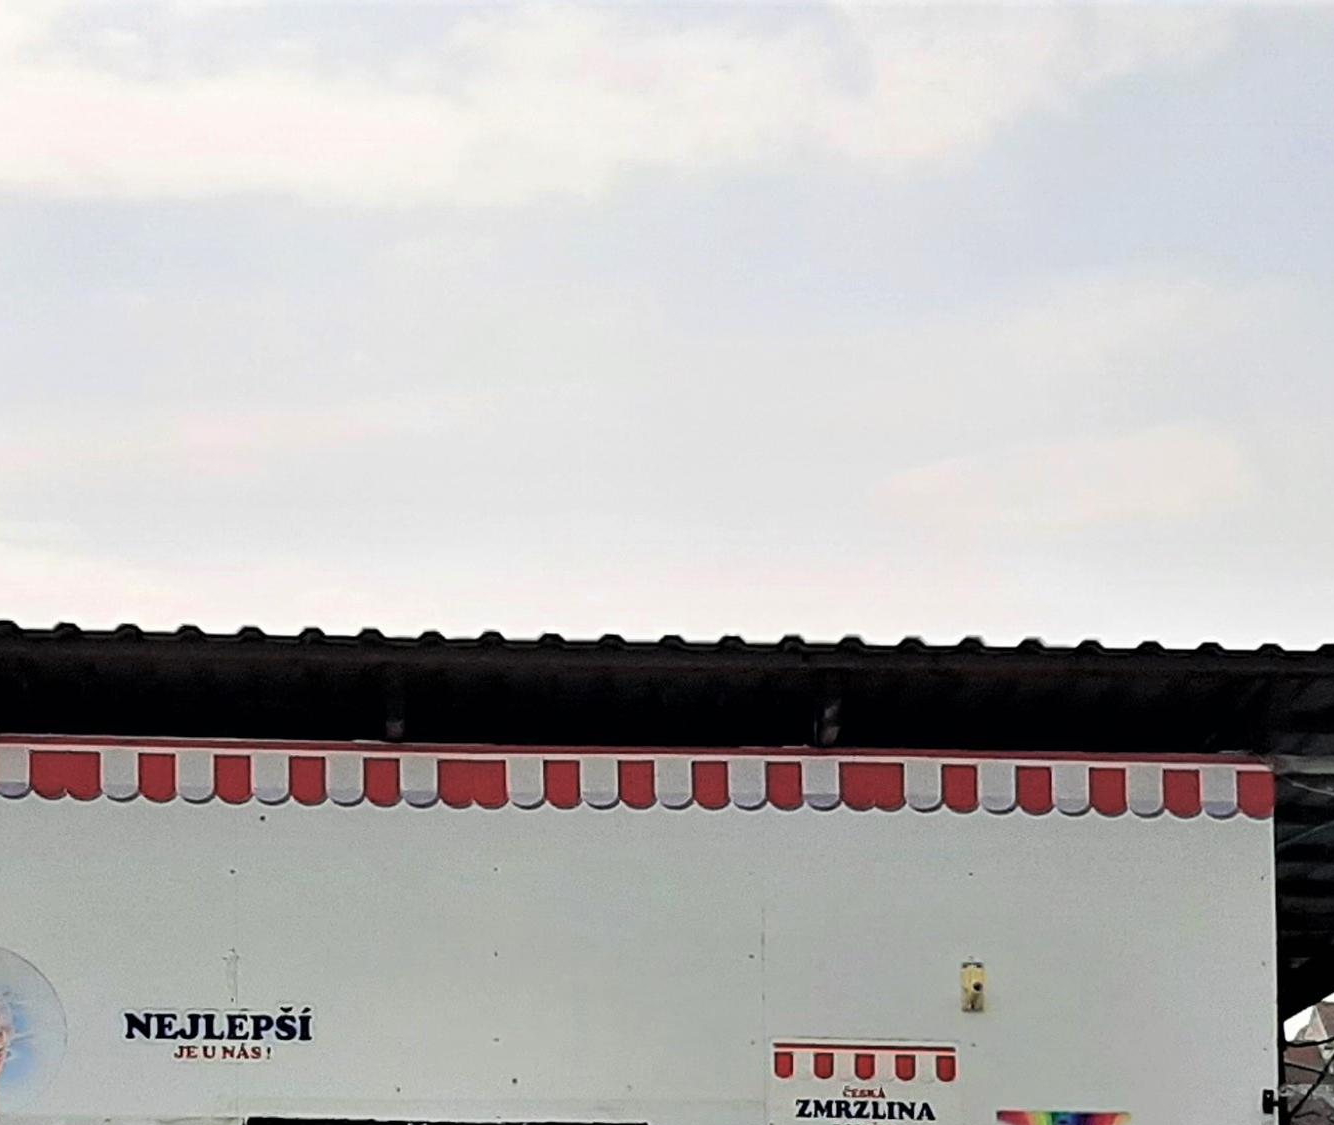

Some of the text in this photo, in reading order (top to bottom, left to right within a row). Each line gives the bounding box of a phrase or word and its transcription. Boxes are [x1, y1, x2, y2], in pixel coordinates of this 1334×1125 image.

[124, 1007, 312, 1041] NEJLEPŠÍ
[174, 1046, 198, 1059] JE
[203, 1046, 216, 1059] U
[221, 1043, 262, 1059] NÁS
[795, 1099, 936, 1121] ZMRZLINA
